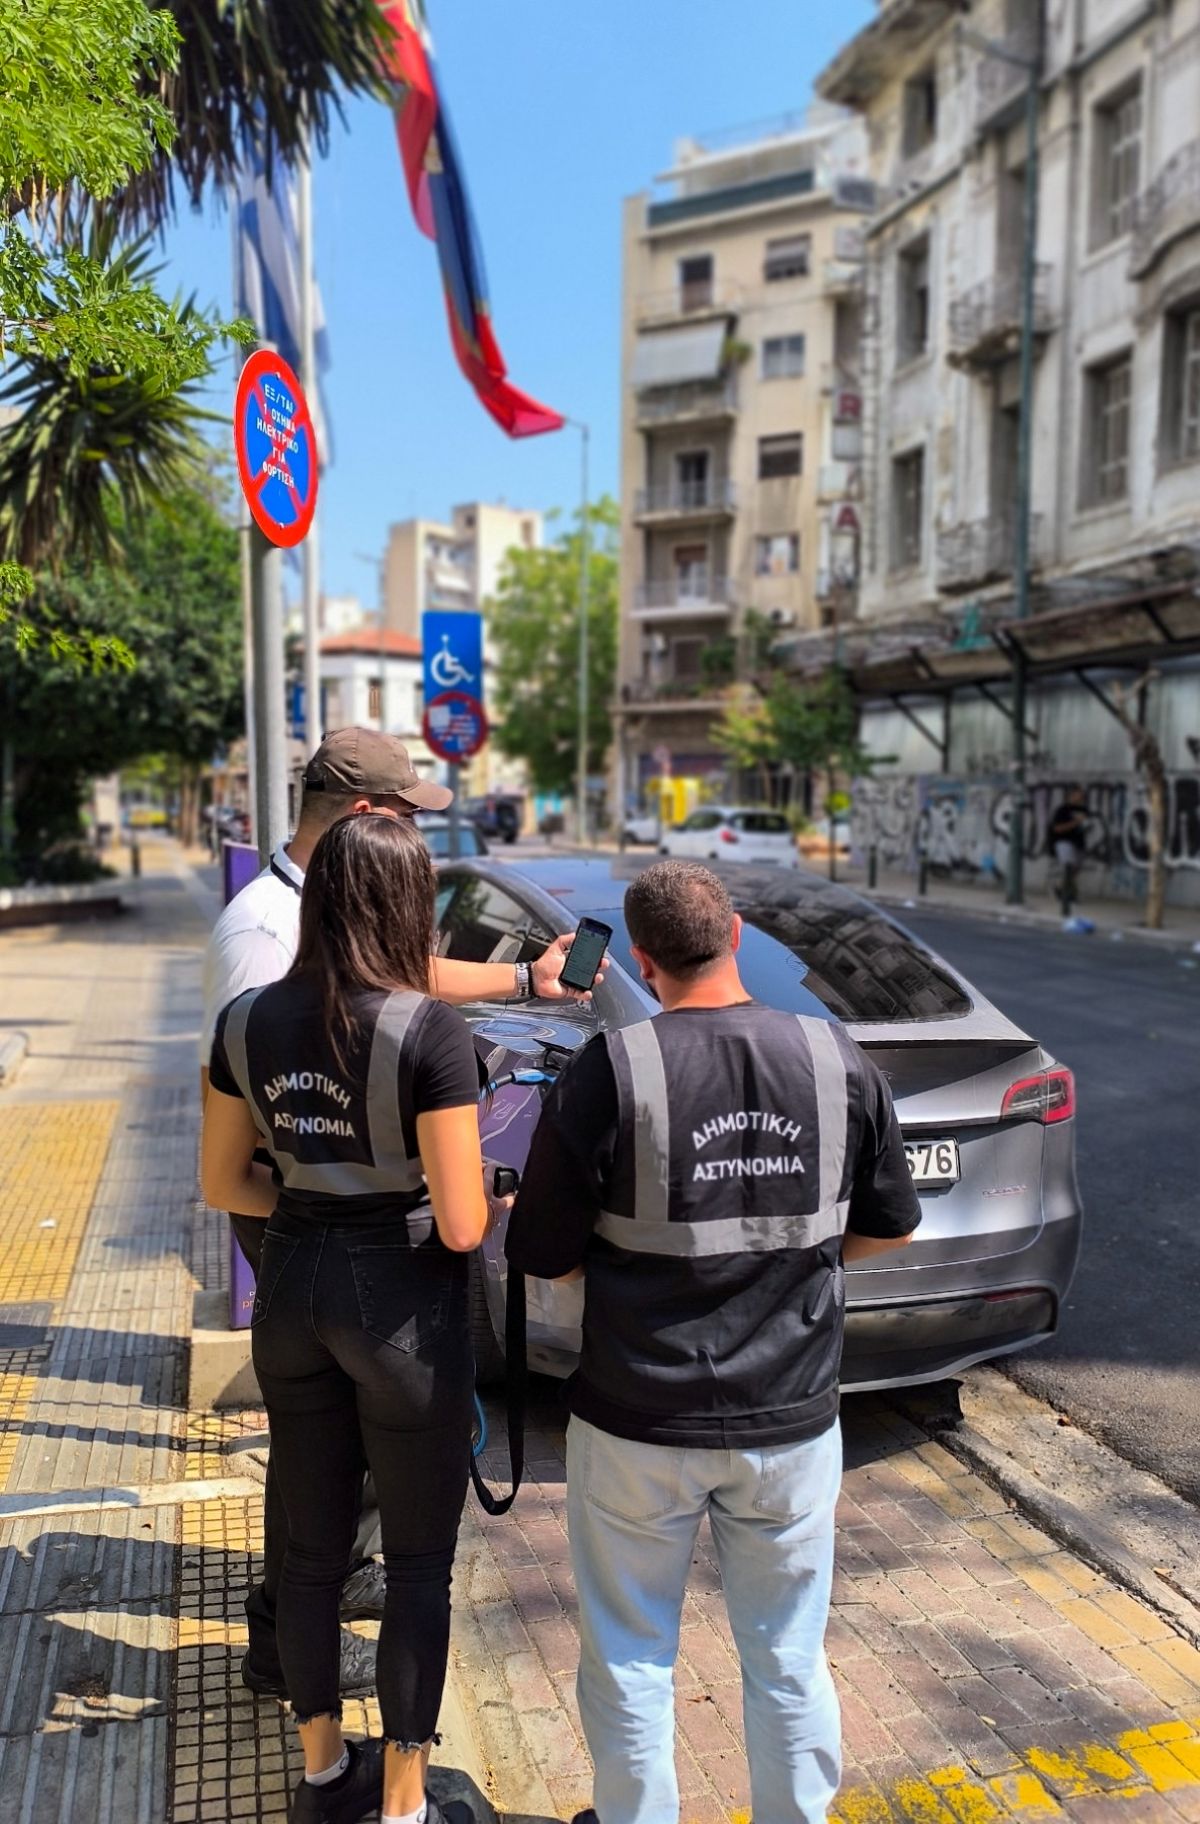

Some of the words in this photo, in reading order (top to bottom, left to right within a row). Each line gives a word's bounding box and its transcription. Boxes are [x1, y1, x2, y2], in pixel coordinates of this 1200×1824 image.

[272, 446, 286, 464] ΓΙΑ
[263, 1071, 352, 1110] ΔΗΜΟΤΙΚΗ
[274, 1112, 356, 1139] ΑΣΥΝΟΜΙΑ
[691, 1111, 803, 1151] ΔΗΜΟΤΙΚΗ
[692, 1155, 806, 1182] ΑΣΤΥΝΟΜΙΑ
